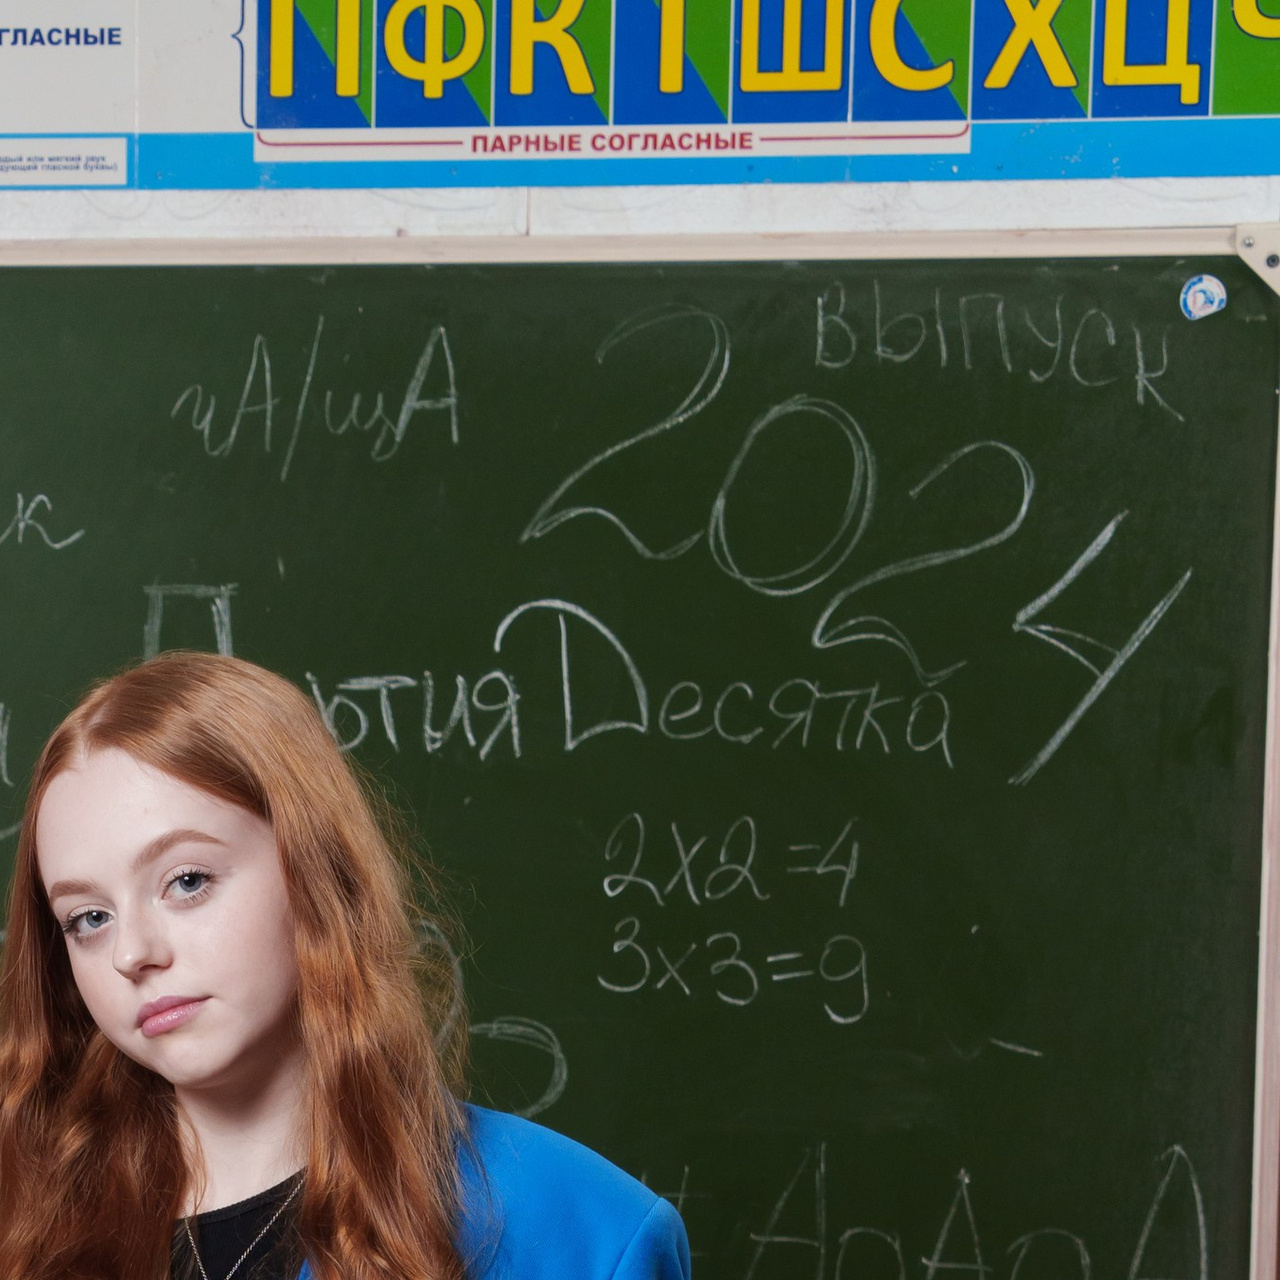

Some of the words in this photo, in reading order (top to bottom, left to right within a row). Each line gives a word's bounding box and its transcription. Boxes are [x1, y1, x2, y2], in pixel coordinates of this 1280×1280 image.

[471, 134, 582, 153] ПАРНЫЕ
[591, 132, 753, 152] СОГЛАСНЫЕ
[519, 302, 1194, 785] 2024
